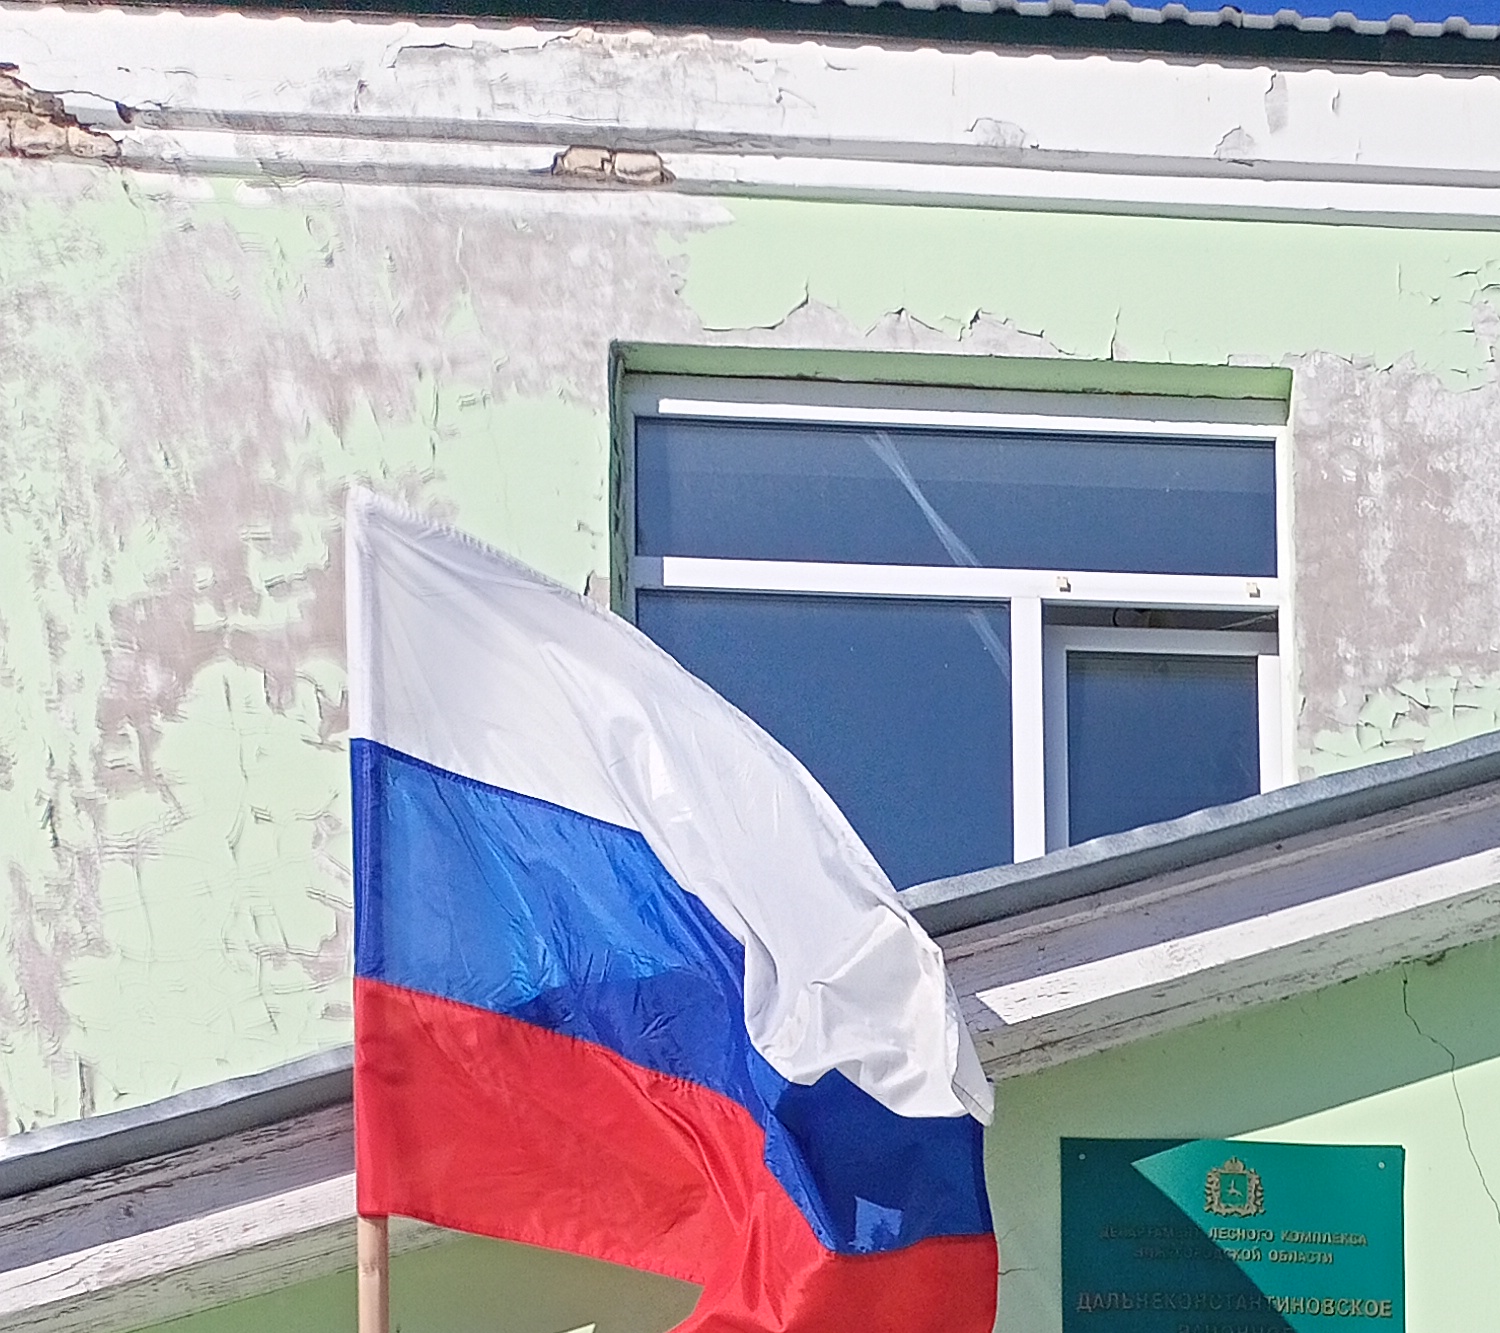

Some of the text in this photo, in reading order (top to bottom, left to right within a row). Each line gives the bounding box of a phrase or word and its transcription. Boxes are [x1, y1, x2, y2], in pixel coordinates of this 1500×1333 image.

[1208, 1227, 1275, 1243] ЛЕСНОГО
[1280, 1230, 1368, 1246] КОМПЛЕКСА
[1268, 1249, 1335, 1265] ОБЛАСТИ
[1076, 1291, 1394, 1319] ДАЛЬНЕКОНСТАНТИНОВСКОЕ
